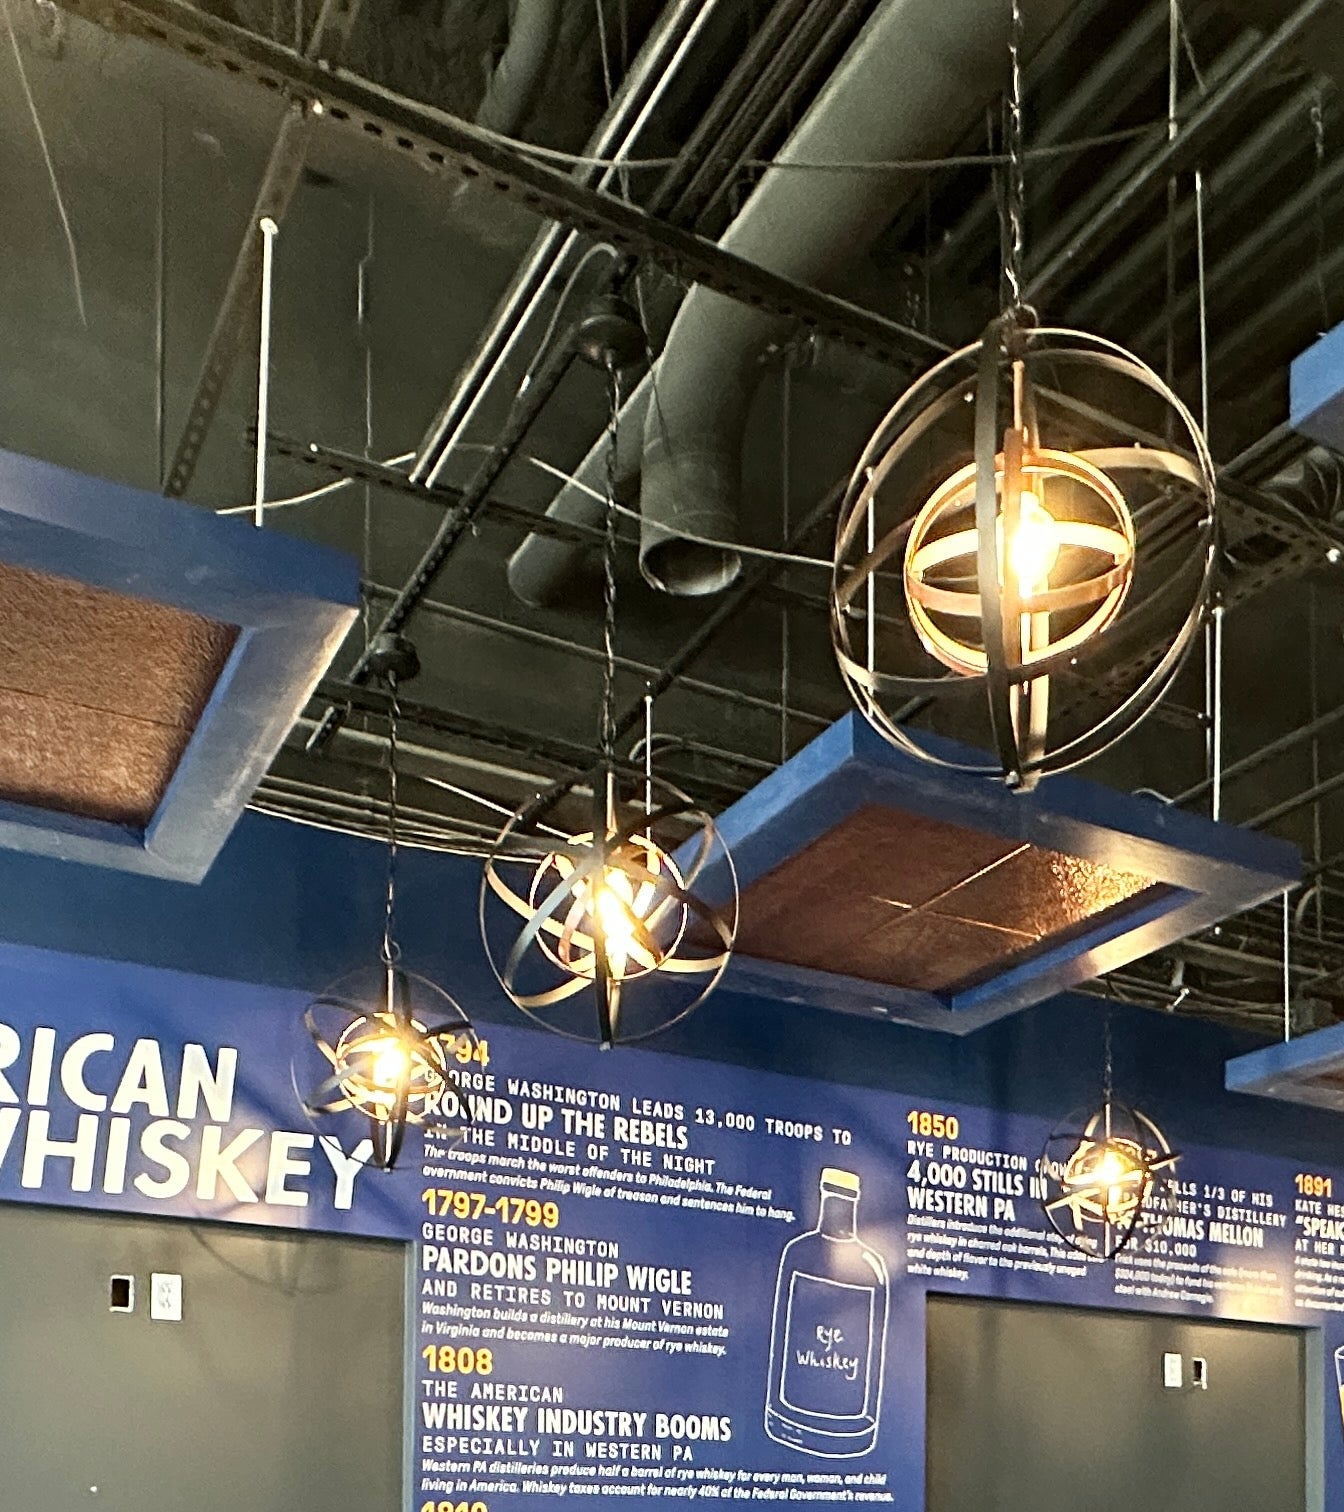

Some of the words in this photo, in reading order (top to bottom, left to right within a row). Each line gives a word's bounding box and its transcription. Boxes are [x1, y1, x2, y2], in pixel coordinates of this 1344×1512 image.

[424, 1091, 513, 1124] ROUND
[521, 1104, 553, 1131] UP
[560, 1108, 605, 1139] THE
[613, 1116, 688, 1150] REBELS
[508, 1078, 620, 1110] WASHINGTON
[632, 1097, 684, 1120] LEADS
[694, 1107, 755, 1131] 13,000
[764, 1118, 823, 1141] TROOPS
[832, 1128, 851, 1146] TO
[907, 1110, 959, 1140] 1850
[907, 1140, 934, 1157] RYE
[942, 1145, 1027, 1171] PRODUCTION
[907, 1160, 967, 1188] 4,000
[971, 1168, 1024, 1196] STILLS
[1029, 1176, 1048, 1201] IN
[1204, 1184, 1225, 1201] 1/3
[1230, 1188, 1246, 1203] OF
[1251, 1192, 1273, 1208] HIS
[1295, 1174, 1332, 1198] 1891
[421, 1188, 559, 1229] 1797-1799
[907, 1186, 988, 1218] WESTERN
[993, 1197, 1016, 1222] PA
[1217, 1205, 1287, 1228] DISTILLERY
[1295, 1199, 1322, 1215] KATE
[422, 1222, 493, 1246] GEORGE
[507, 1234, 619, 1259] WASHINGTON
[1208, 1222, 1264, 1249] MELLON
[1294, 1239, 1309, 1252] AT
[1313, 1241, 1335, 1256] HER
[422, 1244, 537, 1281] PARDONS
[545, 1257, 619, 1288] PHILIP
[625, 1264, 692, 1295] WIGLE
[421, 1279, 457, 1297] AND
[470, 1283, 551, 1306] RETIRES
[562, 1290, 585, 1308] TO
[596, 1293, 652, 1314] MOUNT
[661, 1298, 723, 1320] VERNON
[816, 1325, 844, 1352] Rye
[421, 1344, 493, 1375] 1808
[796, 1350, 859, 1381] Whiskey
[421, 1379, 458, 1398] THE
[470, 1382, 563, 1403] AMERICAN
[421, 1402, 529, 1432] WHISKEY
[537, 1407, 647, 1437] INDUSTRY
[655, 1413, 731, 1442] BOOMS
[422, 1436, 540, 1457] ESPECIALLY
[552, 1440, 574, 1458] IN
[585, 1441, 662, 1461] WESTERN
[673, 1445, 693, 1461] PA
